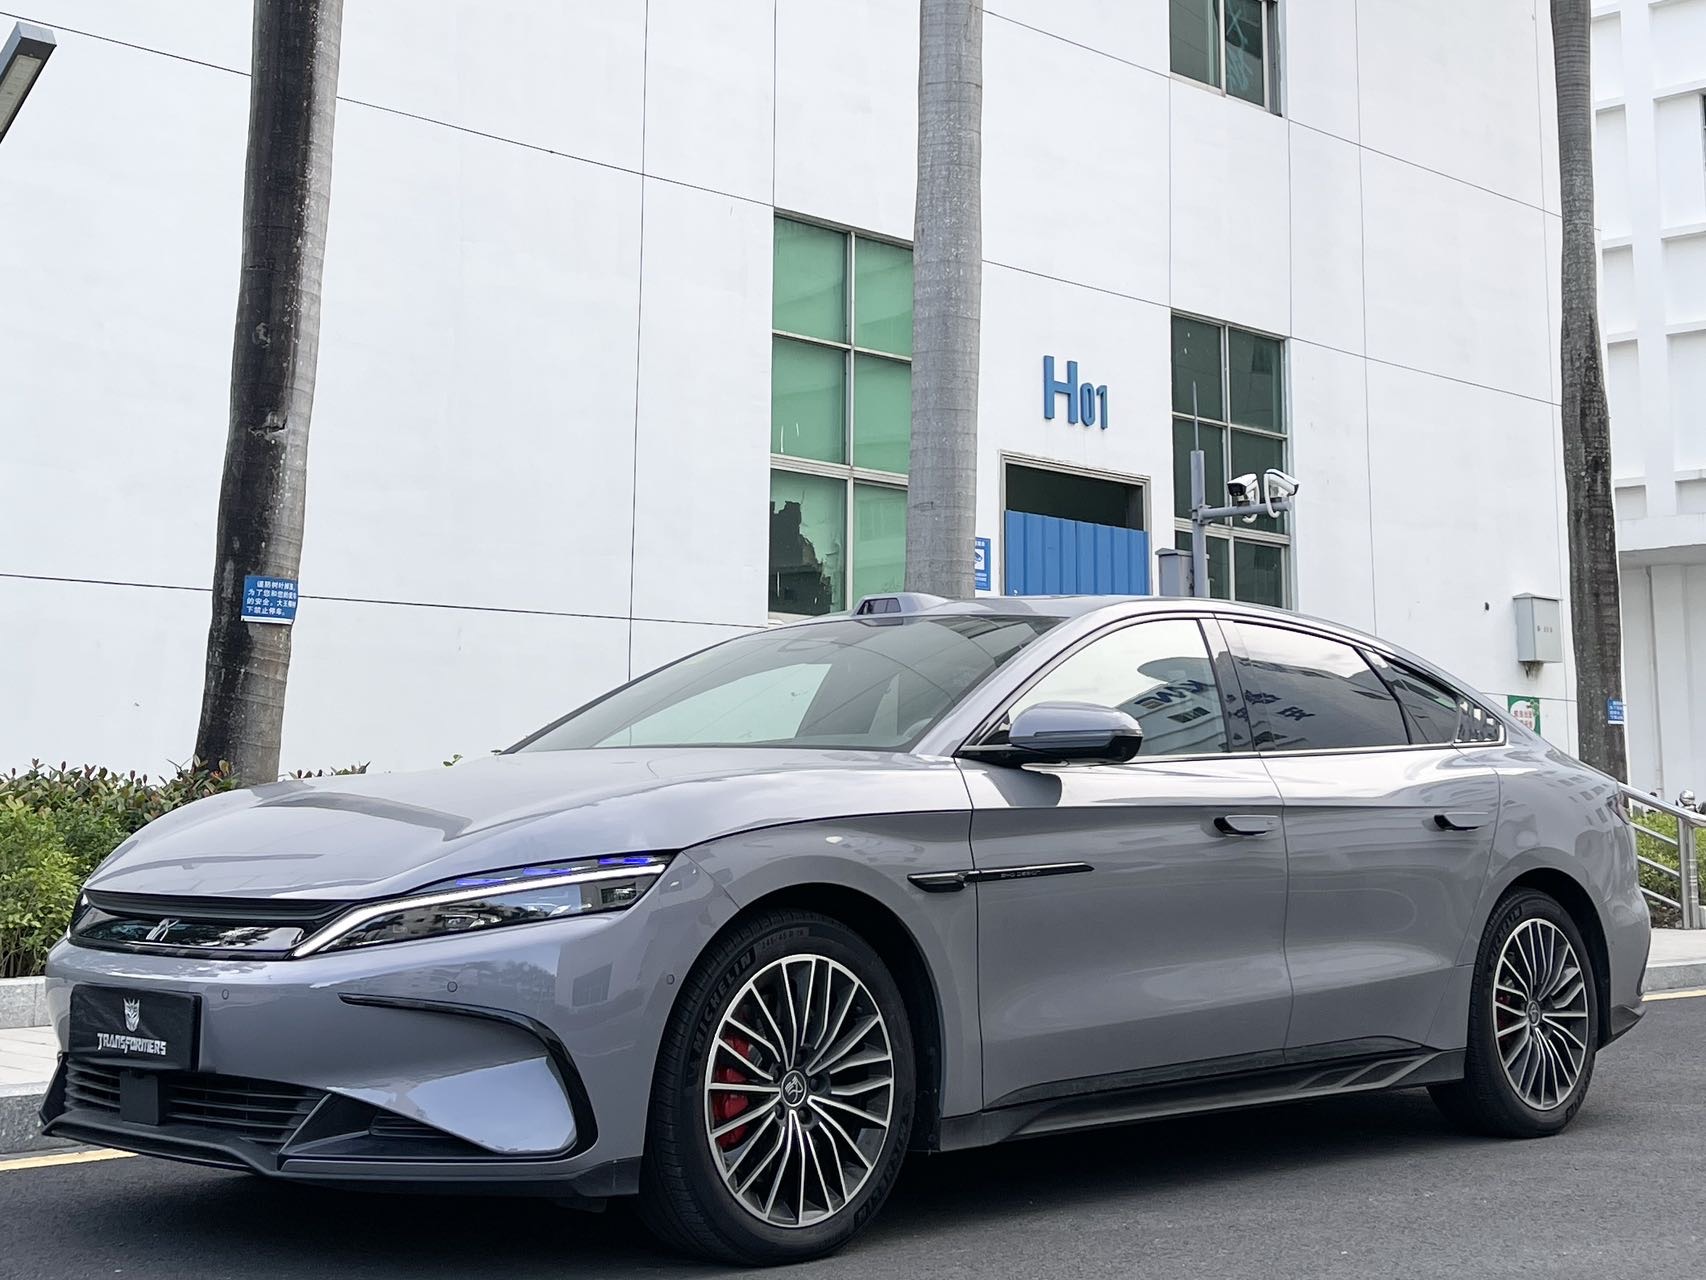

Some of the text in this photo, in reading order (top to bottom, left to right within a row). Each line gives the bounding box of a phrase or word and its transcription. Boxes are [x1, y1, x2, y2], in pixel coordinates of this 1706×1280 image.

[1043, 355, 1108, 430] H01
[693, 951, 753, 1051] MICHELIN
[97, 1032, 167, 1055] TRANSFORMERS
